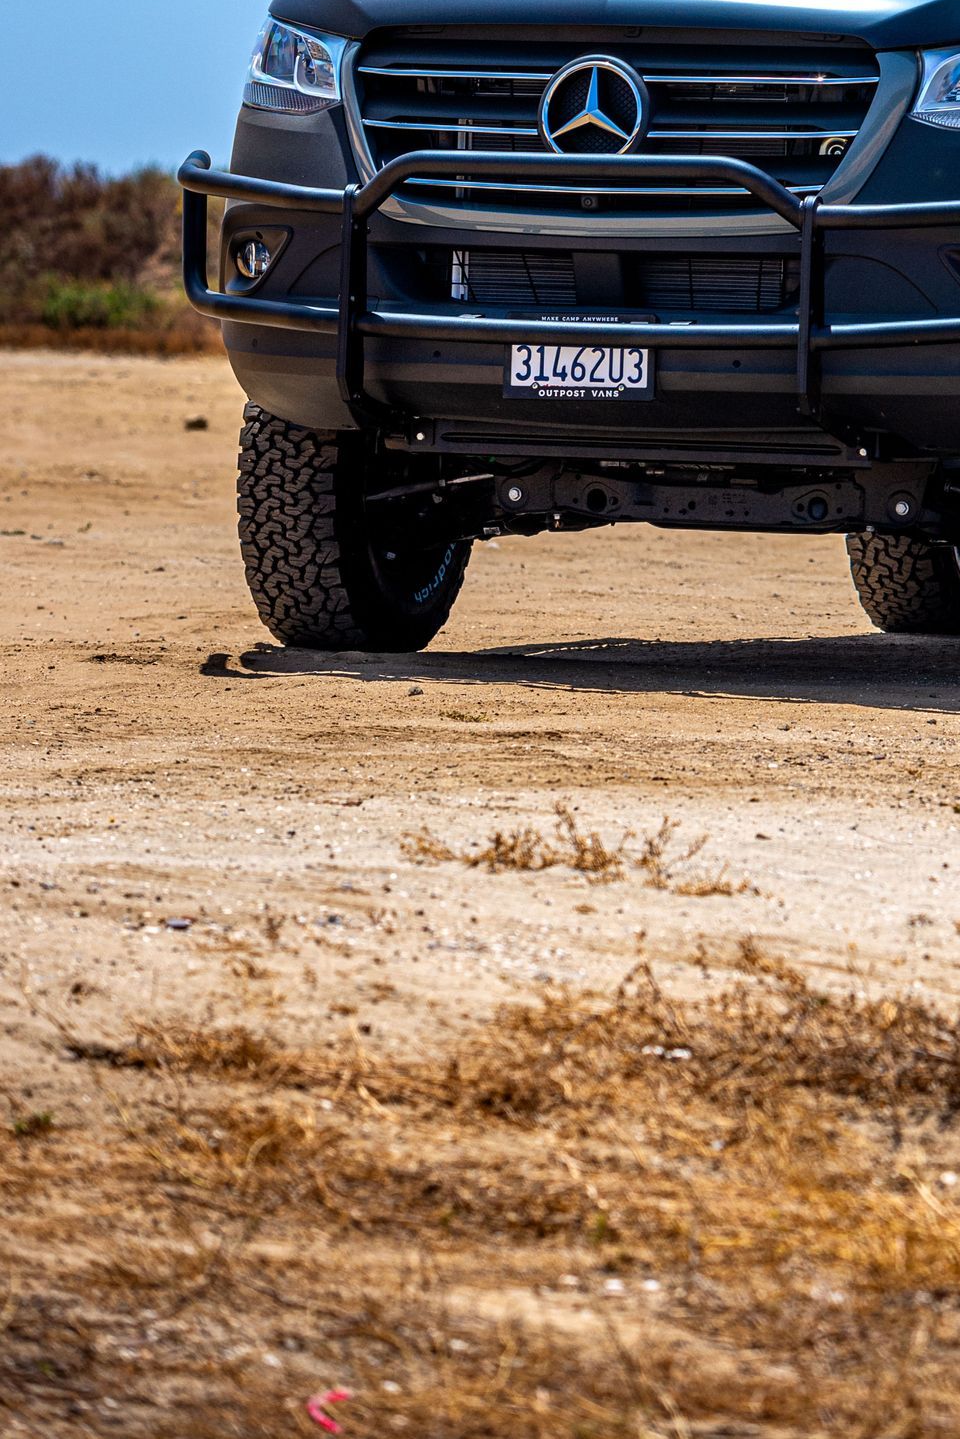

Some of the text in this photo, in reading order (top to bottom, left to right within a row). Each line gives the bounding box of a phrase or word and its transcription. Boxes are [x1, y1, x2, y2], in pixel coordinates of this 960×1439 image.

[515, 344, 644, 383] 31462U3
[538, 389, 620, 398] OUTPOST VANS
